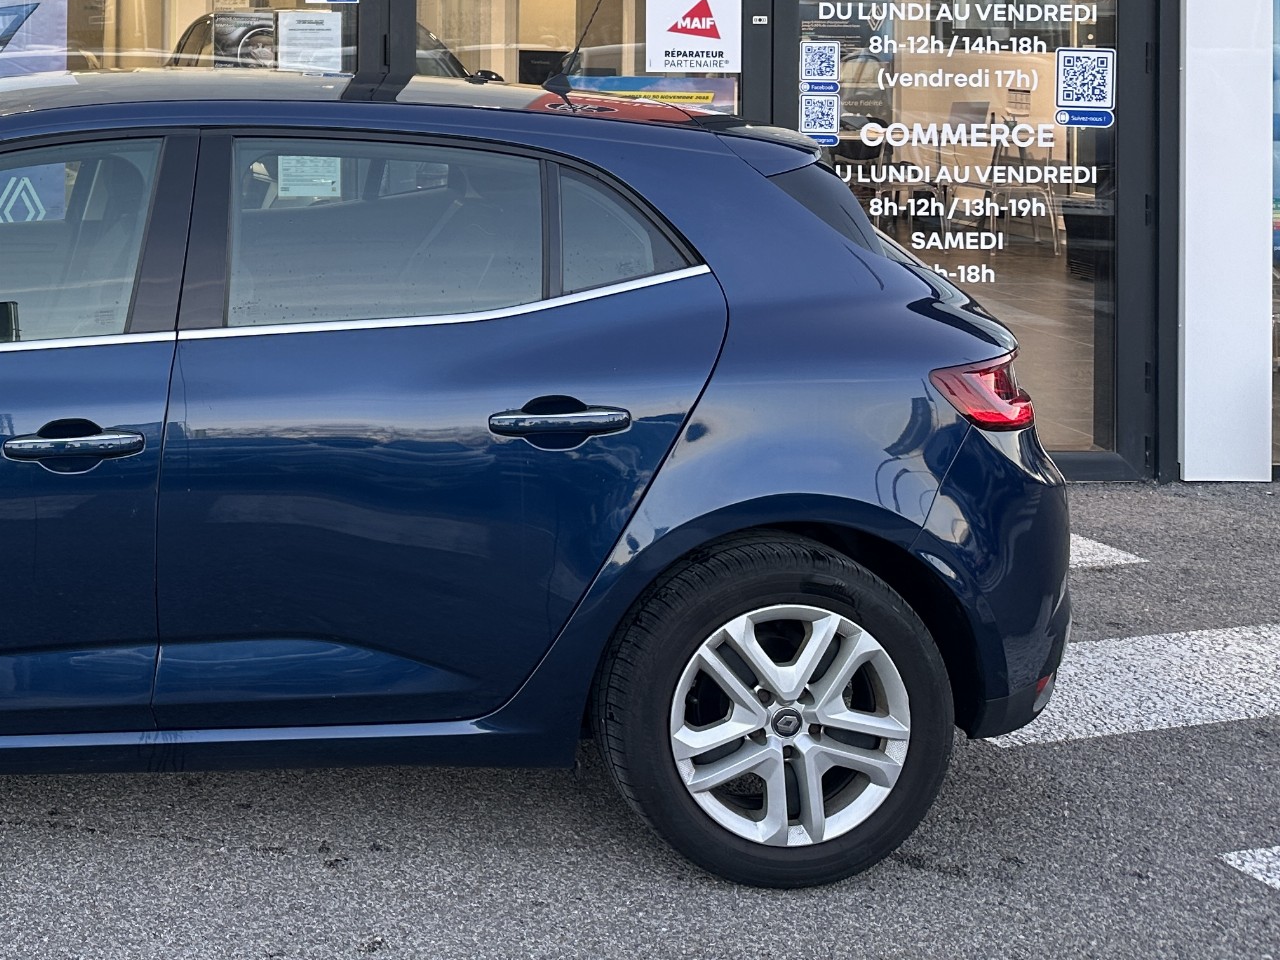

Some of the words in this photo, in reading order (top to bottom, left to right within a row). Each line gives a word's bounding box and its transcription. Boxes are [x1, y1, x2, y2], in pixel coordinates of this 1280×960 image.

[818, 2, 853, 22] DU
[858, 2, 931, 22] LUNDI
[936, 2, 971, 22] AU
[975, 2, 1097, 22] VENDREDI
[677, 17, 714, 30] MAIF
[664, 48, 724, 59] RÉPARATEUR
[868, 36, 945, 56] 8h-12h
[946, 37, 960, 58] /
[962, 37, 1048, 55] 14h-18h
[877, 69, 990, 90] (vendredi
[993, 69, 1039, 90] 17h)
[860, 122, 1055, 148] COMMERCE
[835, 165, 852, 184] U
[858, 165, 931, 184] LUNDI
[936, 165, 971, 184] AU
[975, 165, 1097, 184] VENDREDI
[869, 198, 945, 217] 8h-12h
[946, 198, 960, 220] /
[962, 199, 1047, 217] 13h-19h
[911, 231, 1005, 250] SAMEDI
[927, 265, 996, 283] h-18h
